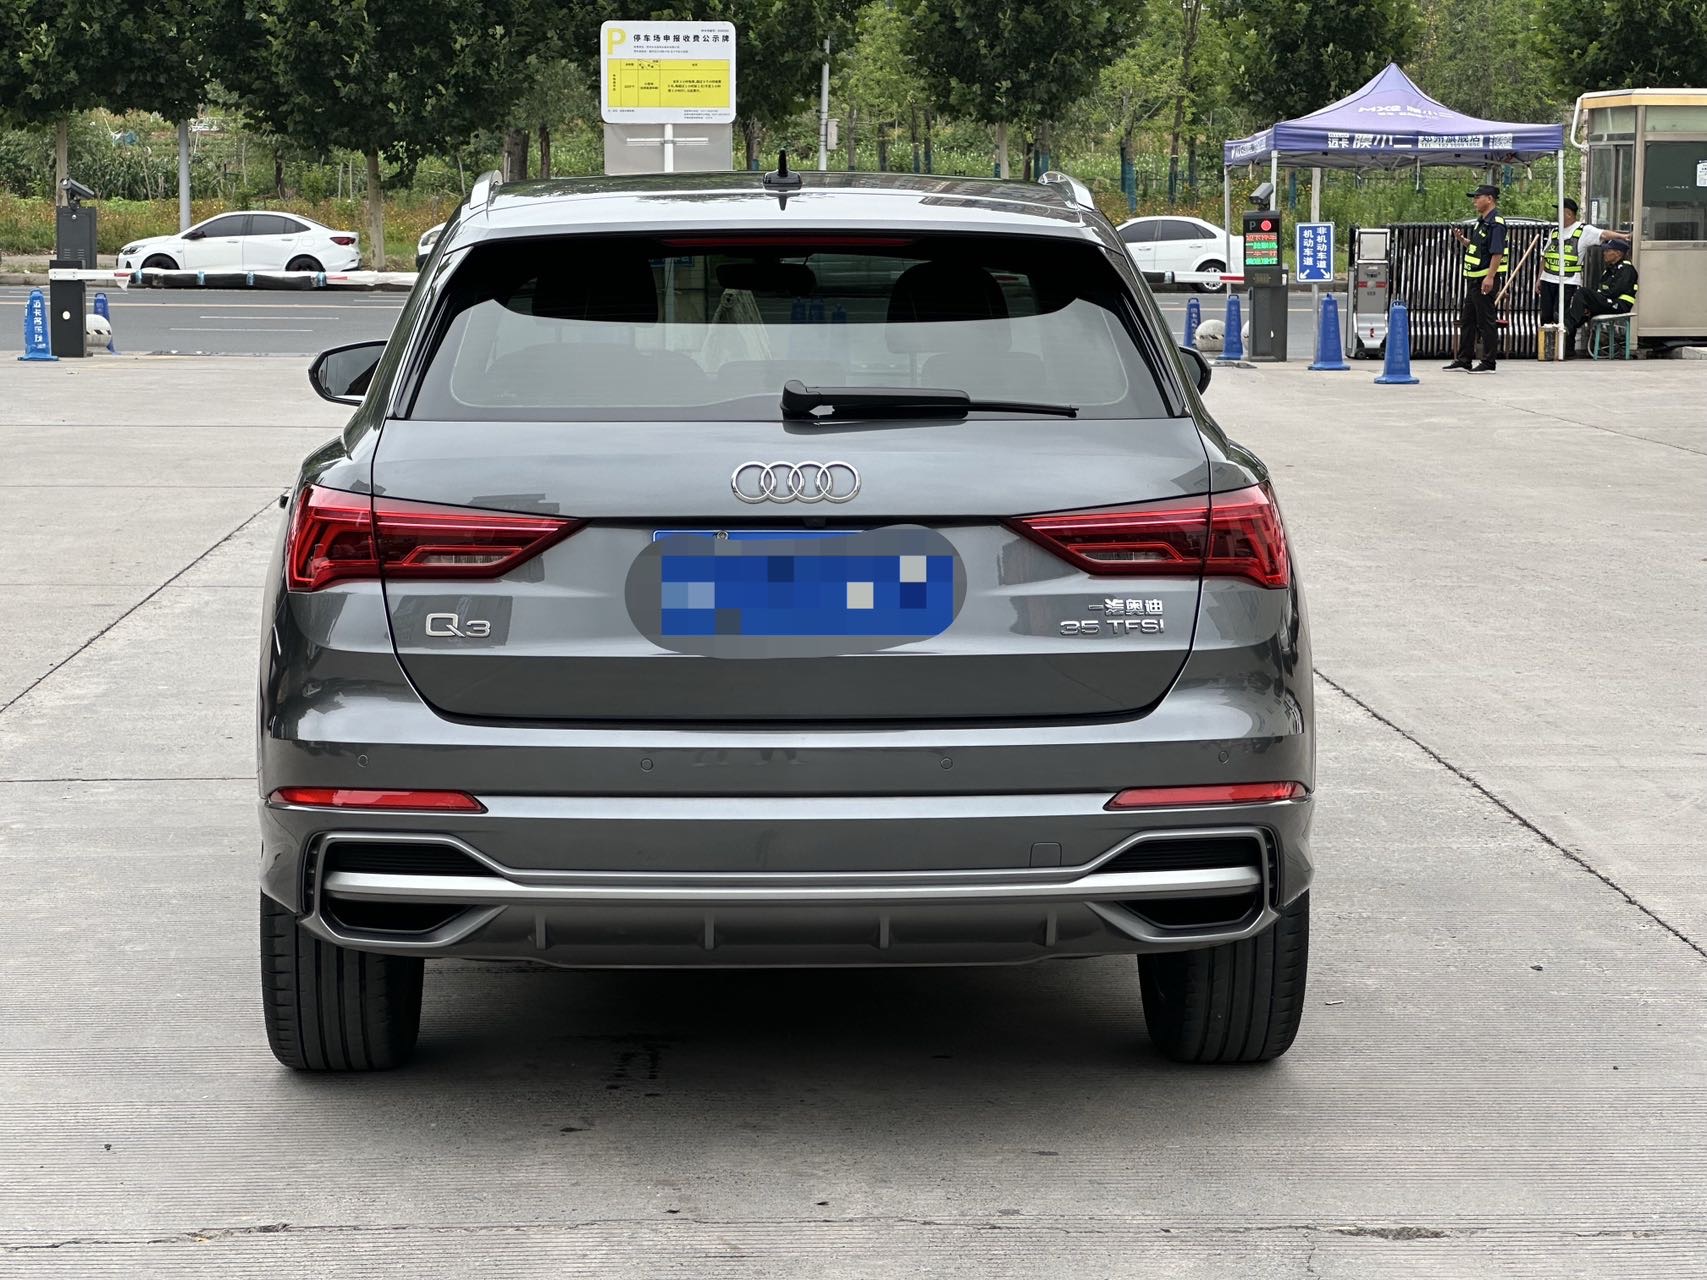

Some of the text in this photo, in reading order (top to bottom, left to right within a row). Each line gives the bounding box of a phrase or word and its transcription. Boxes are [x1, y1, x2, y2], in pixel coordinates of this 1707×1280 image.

[607, 28, 626, 55] P
[633, 34, 730, 43] 停车场申报收费公示牌
[1352, 133, 1413, 149] 膜小二
[1303, 229, 1314, 266] 机动车道
[1316, 227, 1328, 269] 非机动车道
[1088, 598, 1164, 616] 一汽奥迪
[425, 612, 491, 638] Q3
[1060, 619, 1165, 636] 35 TFSI
